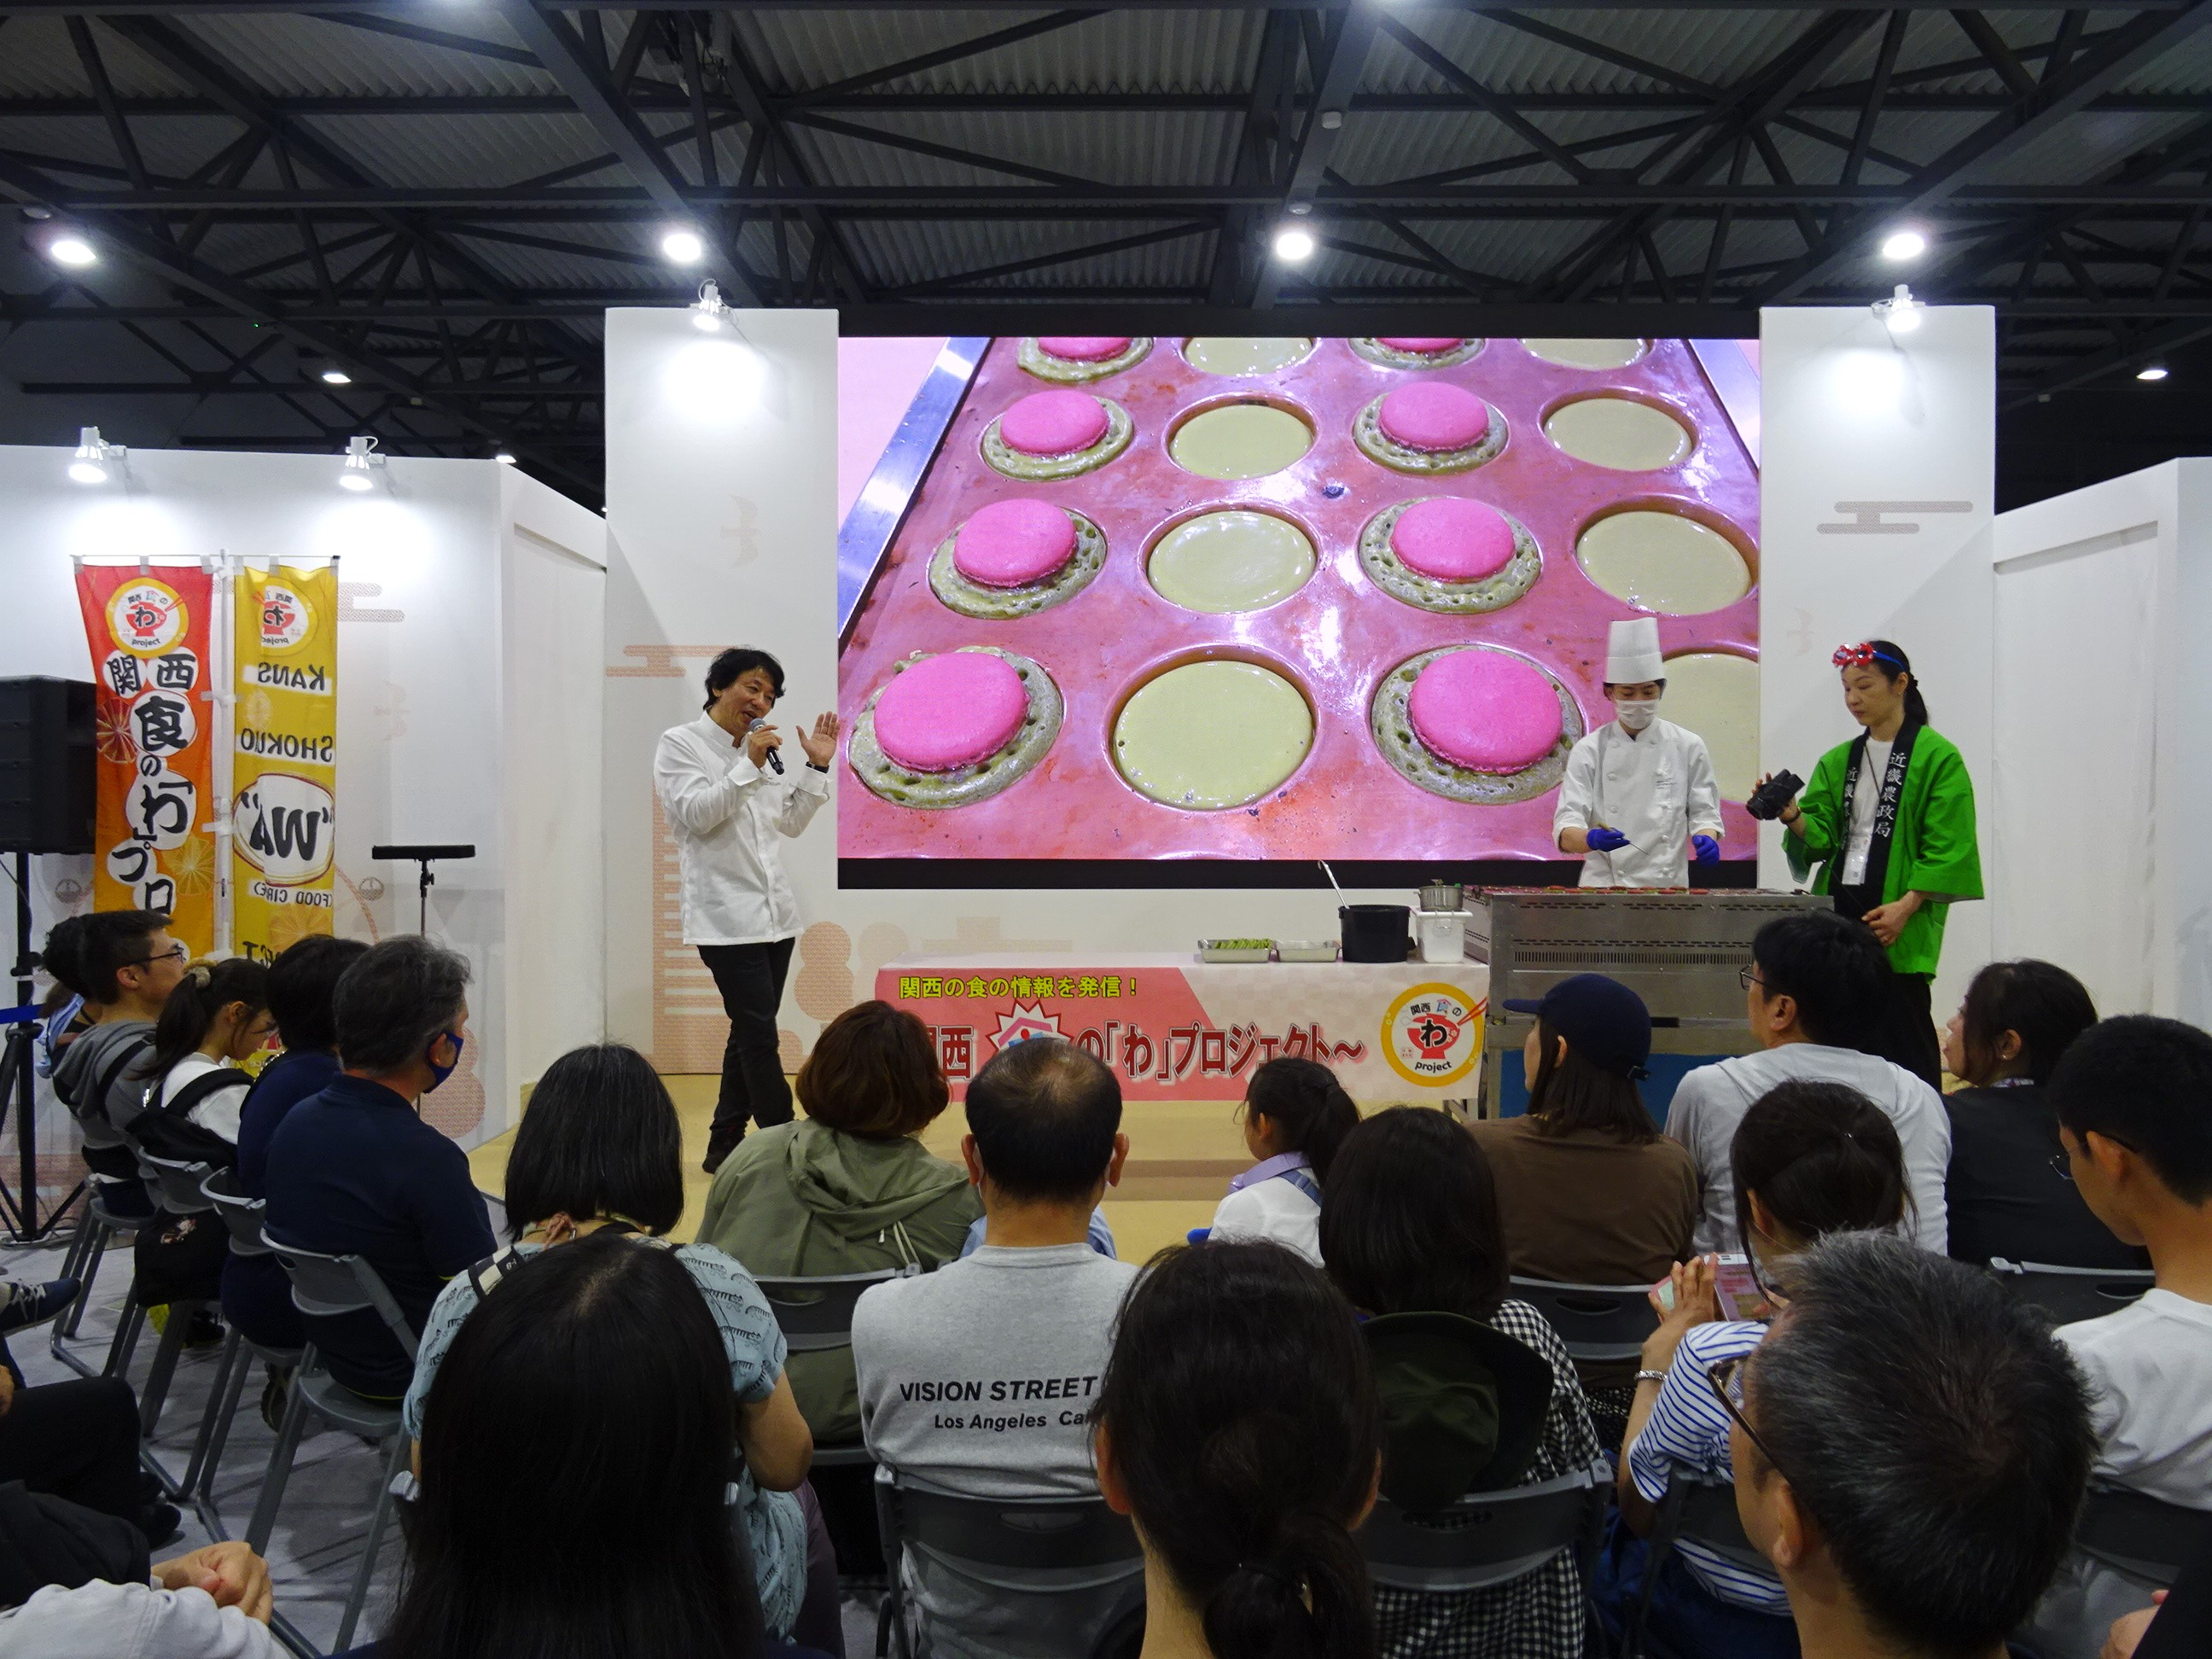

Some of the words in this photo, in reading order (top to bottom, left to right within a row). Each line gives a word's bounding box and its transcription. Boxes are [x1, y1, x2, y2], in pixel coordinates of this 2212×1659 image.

[131, 637, 161, 648] project
[1874, 752, 1907, 838] 近畿農政局
[899, 975, 1137, 998] 関西の食の情報を発信！
[1420, 1019, 1447, 1047] わ
[1415, 1061, 1452, 1074] project
[899, 1380, 982, 1402] VISION
[989, 1376, 1098, 1400] STREET
[935, 1414, 964, 1429] Los
[969, 1412, 1047, 1432] Angeles
